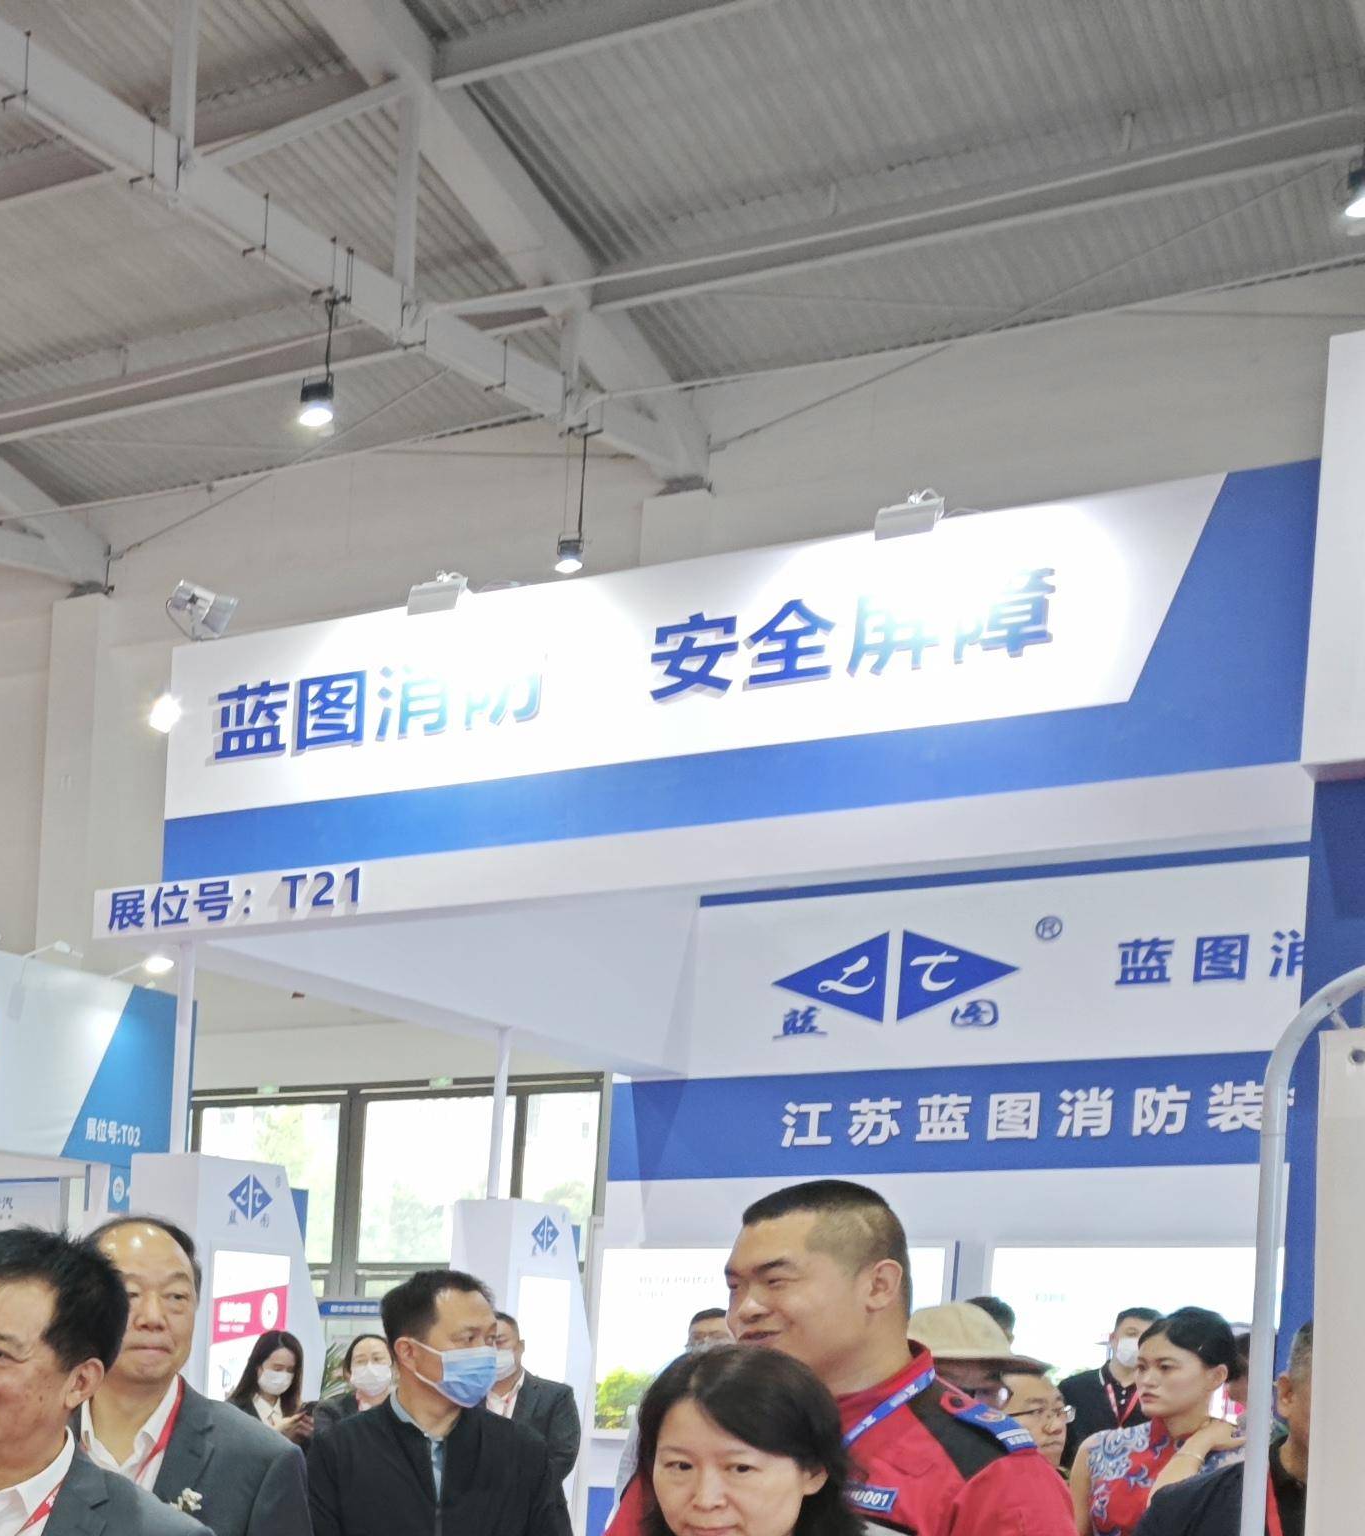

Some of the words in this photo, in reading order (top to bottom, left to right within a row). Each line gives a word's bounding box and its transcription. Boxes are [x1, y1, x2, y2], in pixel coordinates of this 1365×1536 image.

[650, 568, 1056, 704] 安全屏障
[780, 1080, 1294, 1149] 江苏蓝图消防装
[851, 1490, 889, 1507] U001
